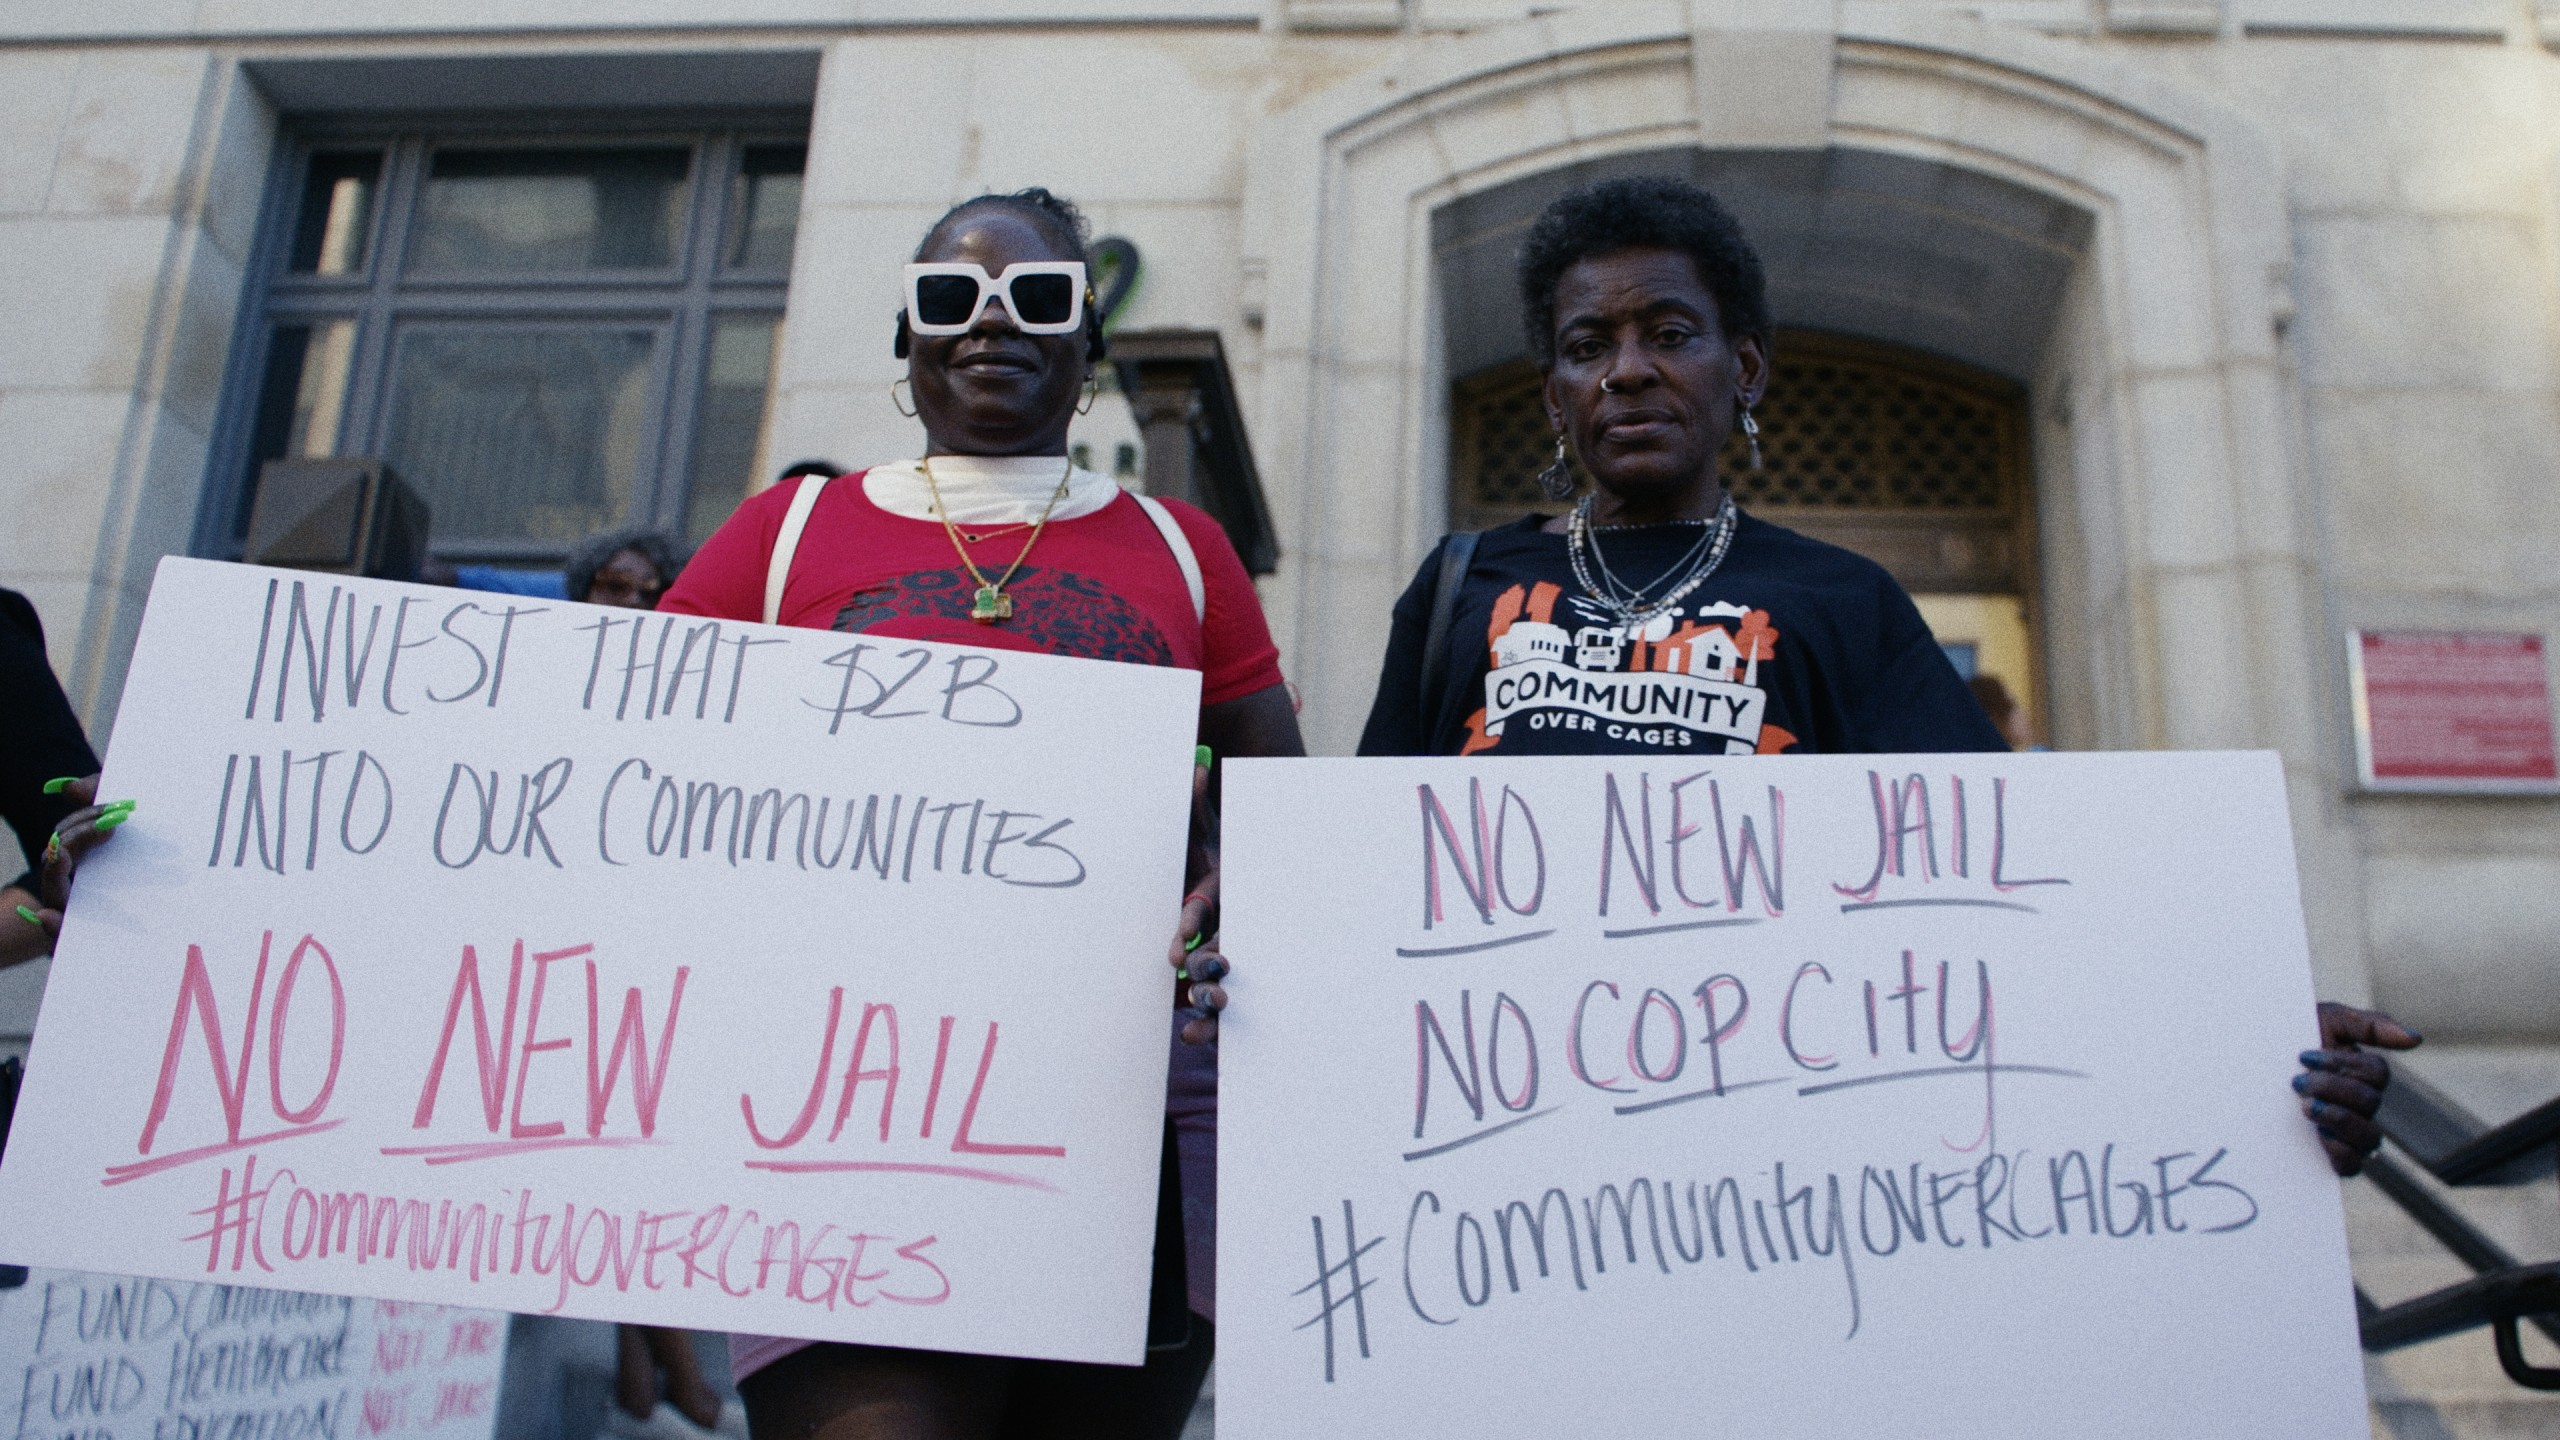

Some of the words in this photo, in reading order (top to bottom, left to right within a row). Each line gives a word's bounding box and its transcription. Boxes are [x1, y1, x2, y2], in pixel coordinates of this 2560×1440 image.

[245, 578, 551, 723] INVEST
[573, 614, 791, 723] THAT
[799, 643, 1024, 736] $2B
[1495, 670, 1751, 729] COMMUNITY
[1529, 711, 1597, 733] OVER
[1606, 724, 1693, 748] CAGES
[207, 749, 394, 875] INTO
[432, 756, 575, 869] OUR
[1416, 774, 1546, 932] NO
[1599, 769, 1785, 918] NEW
[1831, 769, 2072, 902] JAIL
[137, 929, 347, 1155] NO
[412, 937, 691, 1139] NEW
[740, 985, 1067, 1158] JAIL
[1413, 988, 1540, 1139] NO
[1566, 972, 1749, 1097] COP
[34, 1275, 180, 1356] FUND
[14, 1355, 147, 1440] FUND
